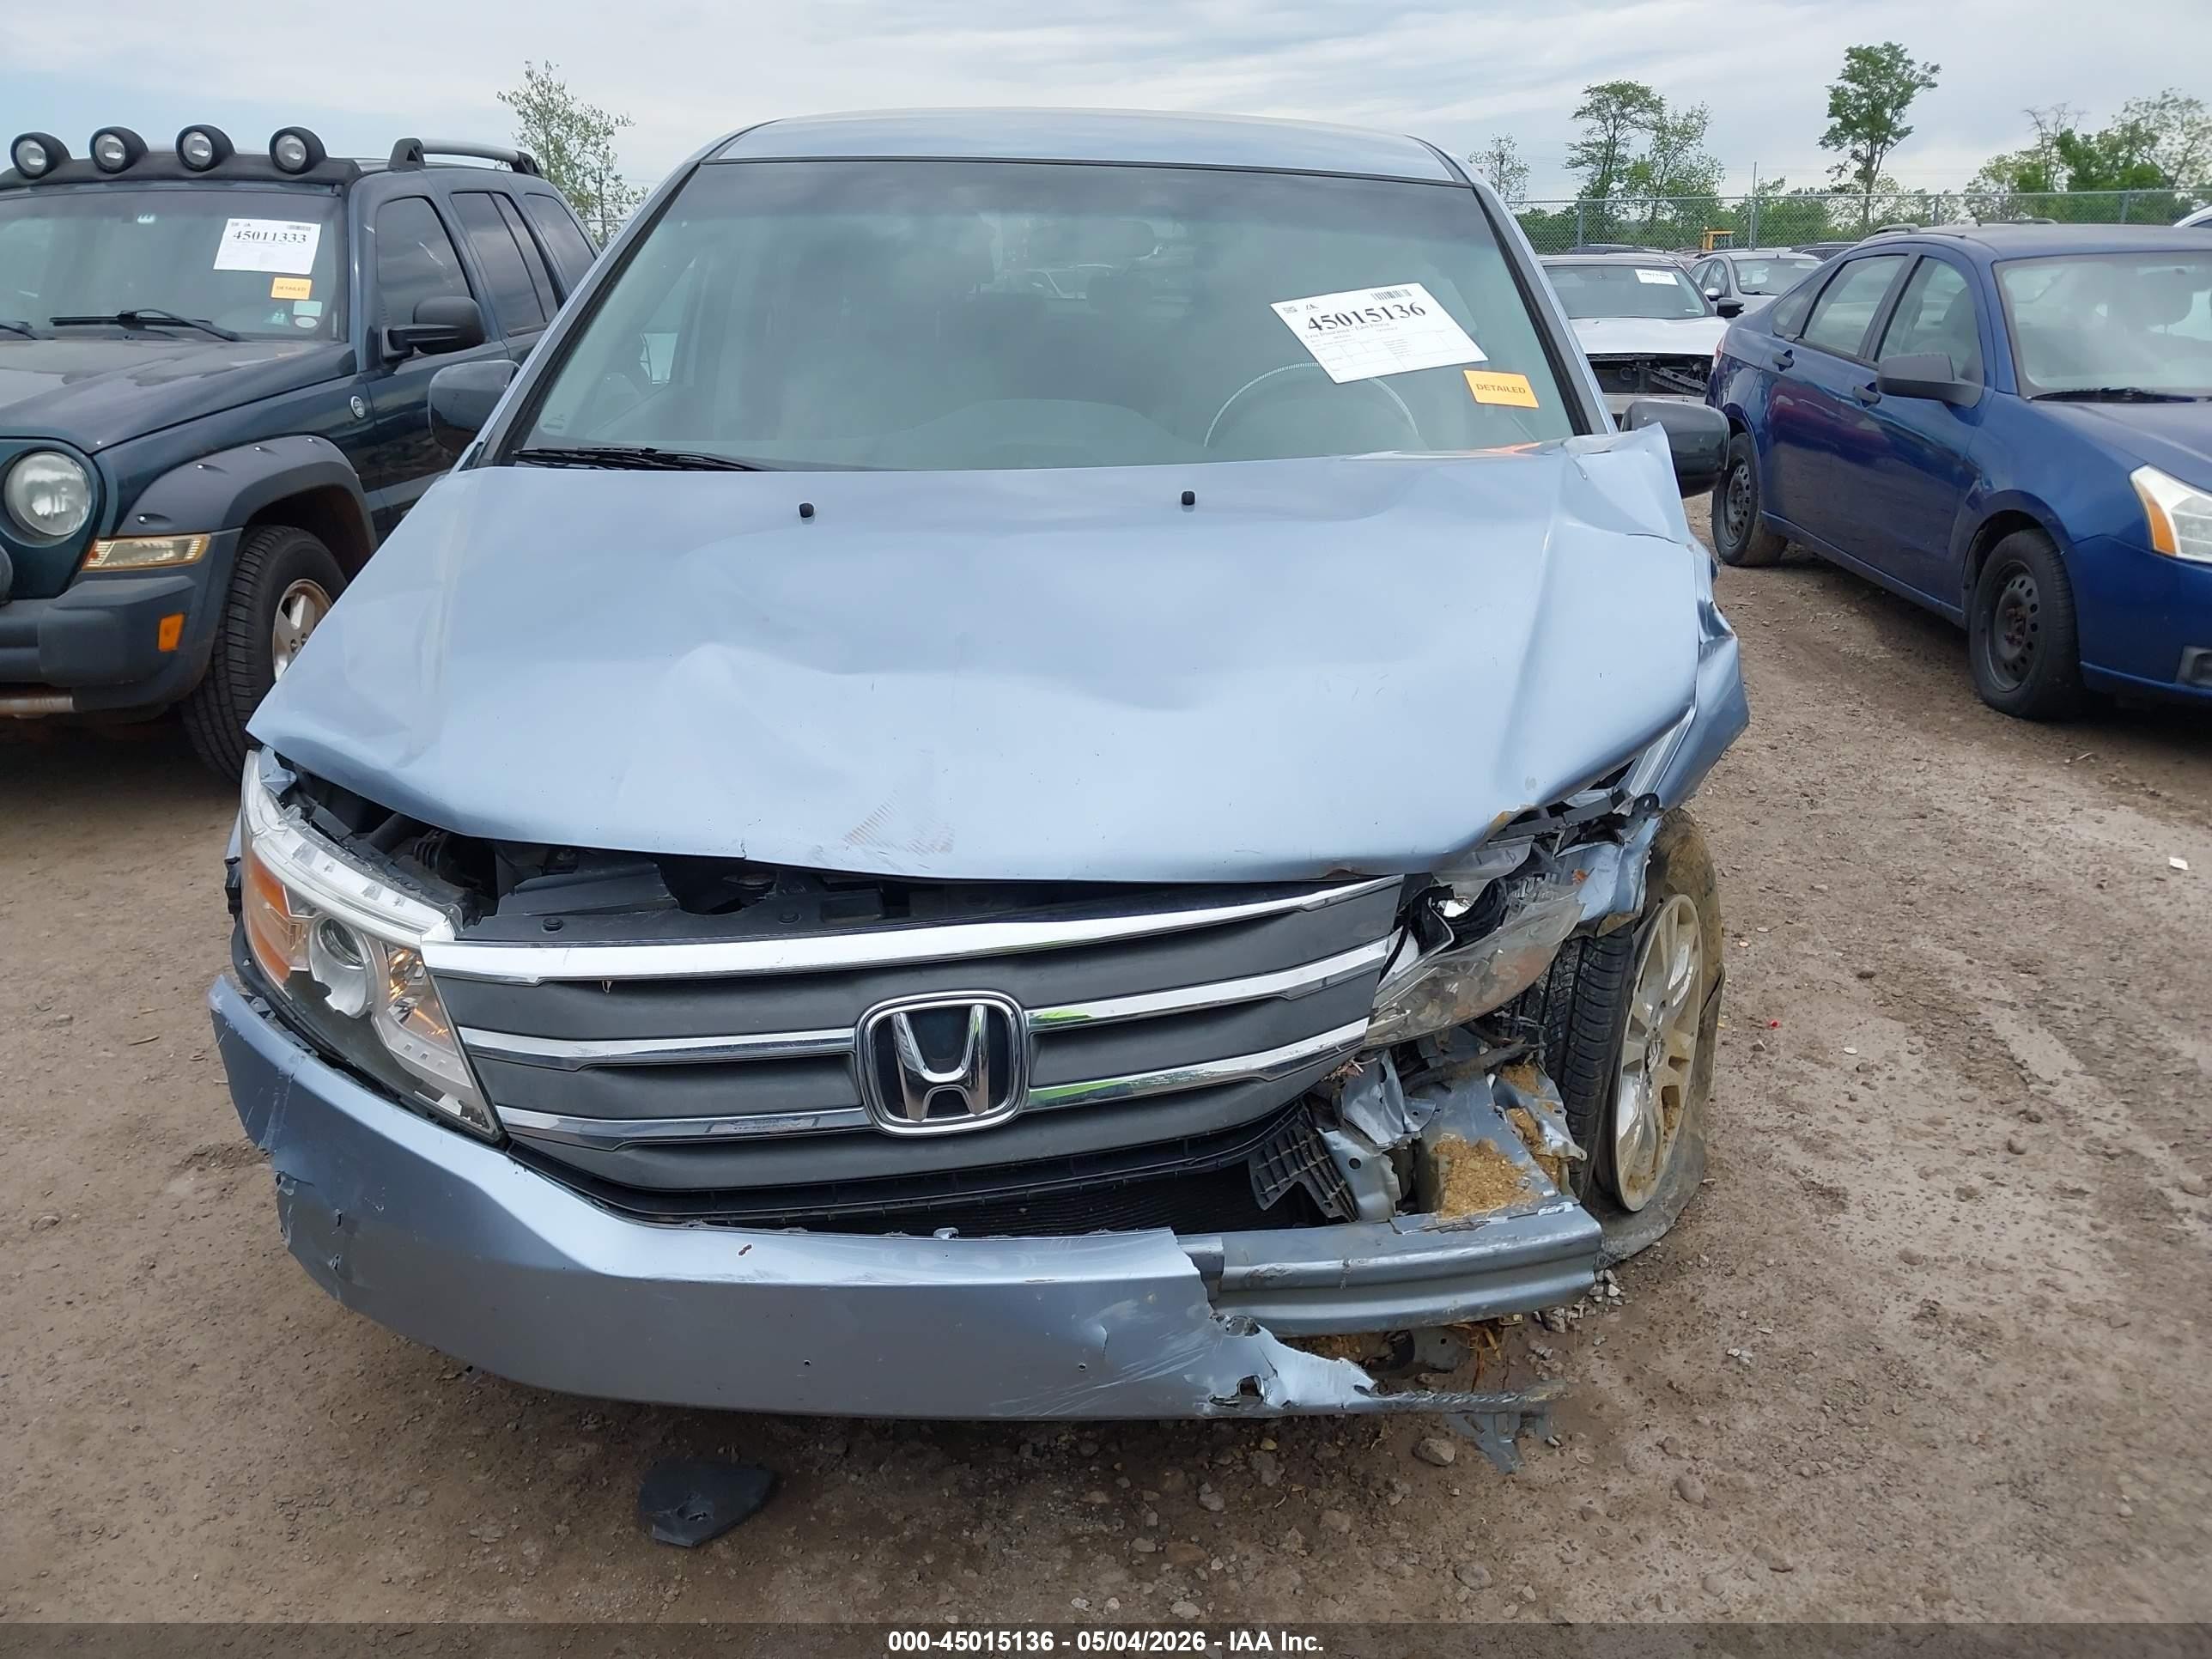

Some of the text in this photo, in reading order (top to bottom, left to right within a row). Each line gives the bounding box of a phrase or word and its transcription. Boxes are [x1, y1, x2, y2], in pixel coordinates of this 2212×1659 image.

[234, 231, 307, 244] 45011333
[1308, 301, 1426, 331] 45015136
[1476, 383, 1526, 394] DETAILED
